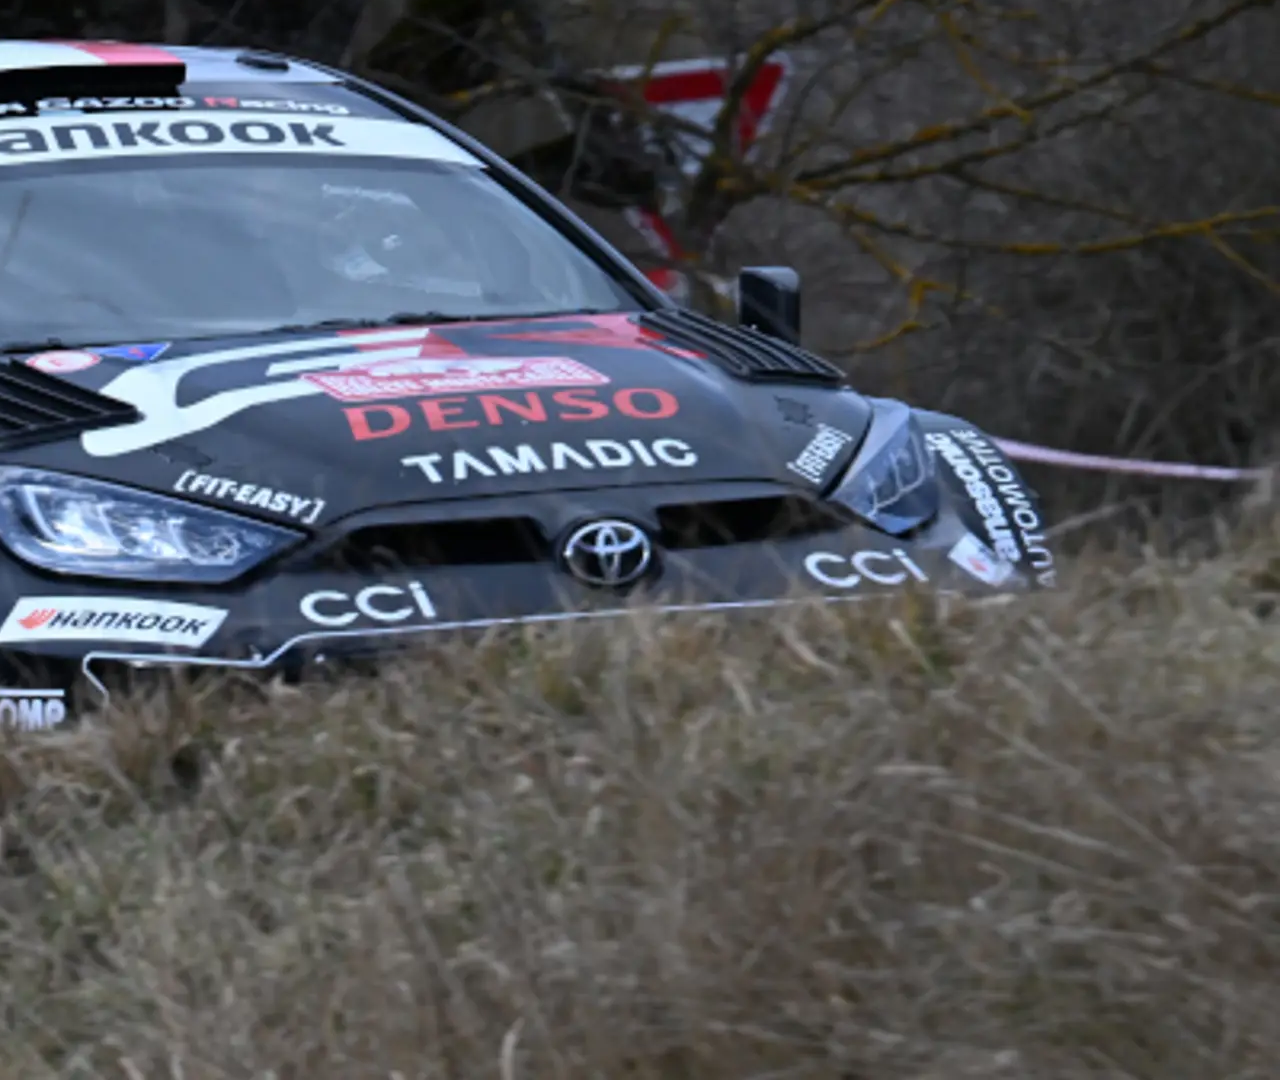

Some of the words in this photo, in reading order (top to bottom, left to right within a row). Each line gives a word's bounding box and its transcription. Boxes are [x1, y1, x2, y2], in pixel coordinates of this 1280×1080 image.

[37, 94, 196, 113] GAZOO
[344, 388, 680, 441] DENSO
[401, 437, 699, 484] TAMADIC
